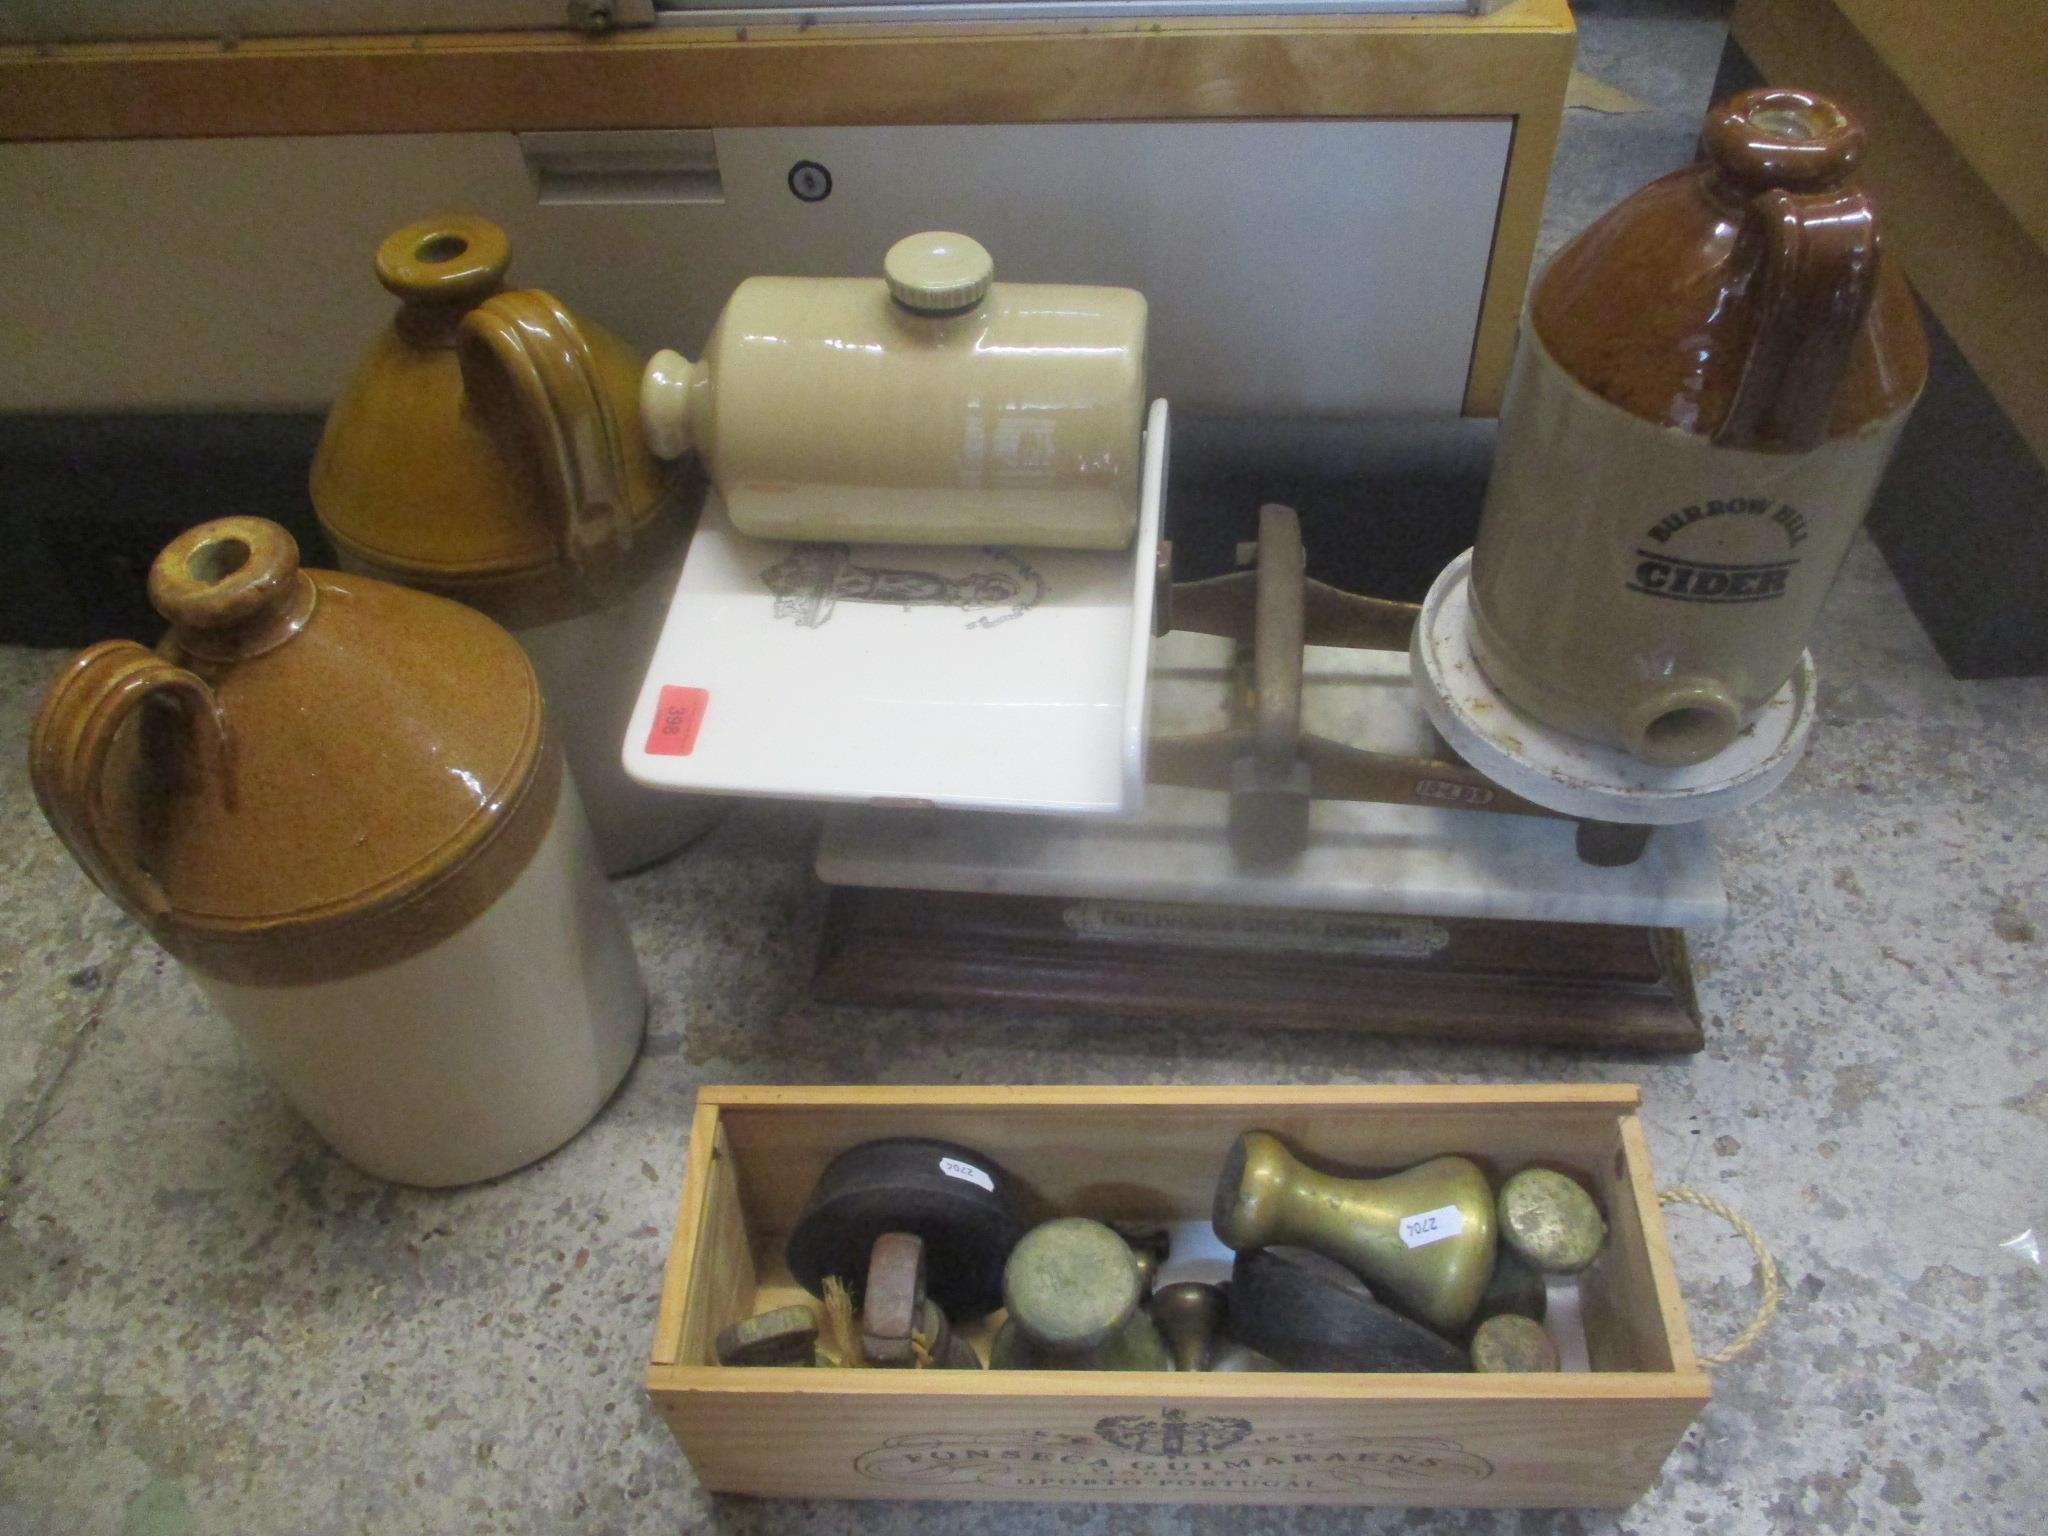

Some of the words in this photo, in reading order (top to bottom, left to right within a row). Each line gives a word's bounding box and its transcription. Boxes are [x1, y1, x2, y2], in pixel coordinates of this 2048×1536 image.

[1647, 496, 1776, 543] BURROW
[1771, 504, 1809, 549] HILL
[1636, 560, 1792, 597] CIDER
[1405, 1216, 1438, 1237] 2704
[904, 1448, 1109, 1469] FONSECA
